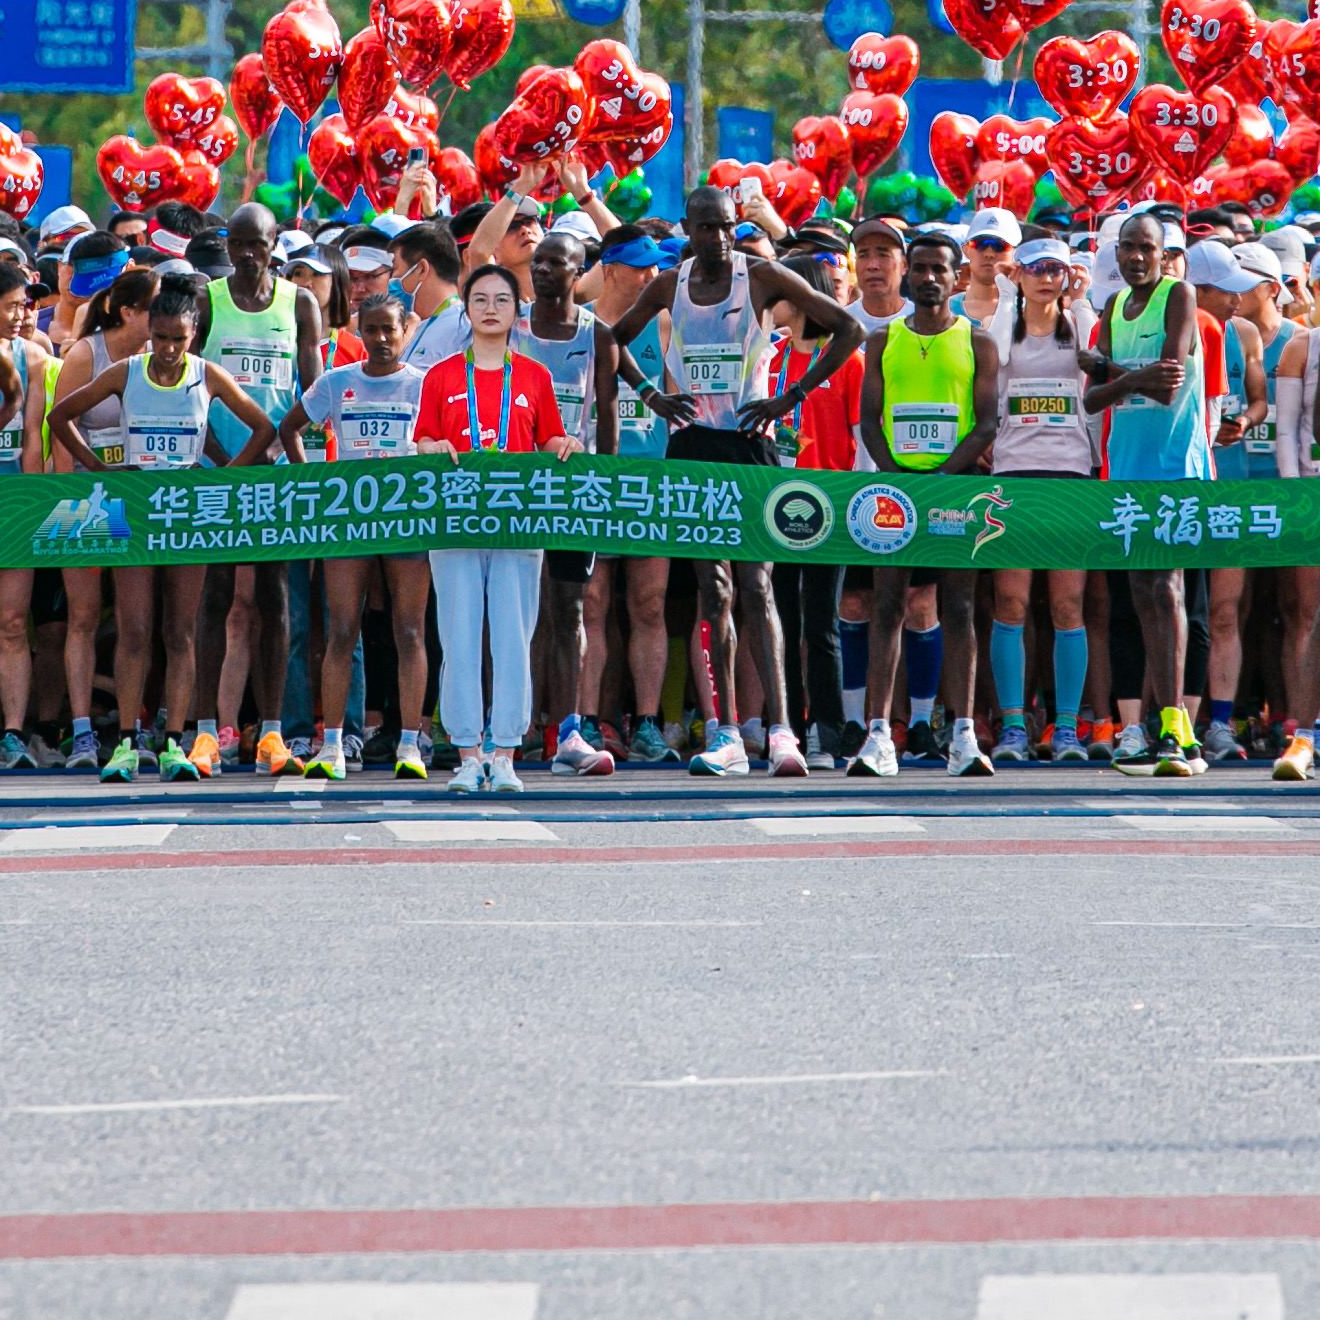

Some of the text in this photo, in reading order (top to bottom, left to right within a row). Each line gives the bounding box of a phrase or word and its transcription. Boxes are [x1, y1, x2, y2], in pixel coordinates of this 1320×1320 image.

[1168, 7, 1221, 42] 3:30
[1068, 59, 1128, 88] 3:30
[601, 59, 657, 113] 3:30
[170, 104, 216, 125] 5:45
[1155, 102, 1218, 127] 3:30
[533, 104, 582, 158] 3:30
[1069, 151, 1130, 174] 3:30
[3, 172, 42, 192] 4:45
[112, 165, 161, 190] 4:45
[241, 357, 272, 374] 006
[691, 364, 721, 380] 002
[360, 420, 390, 437] 032
[909, 423, 939, 439] 008
[146, 435, 177, 452] 036
[148, 468, 743, 529] 华夏银行2023密云生态马拉松
[927, 508, 977, 523] CHINA
[147, 515, 742, 551] HUAXIA BANK MIYUN ECO MARATHON 2023
